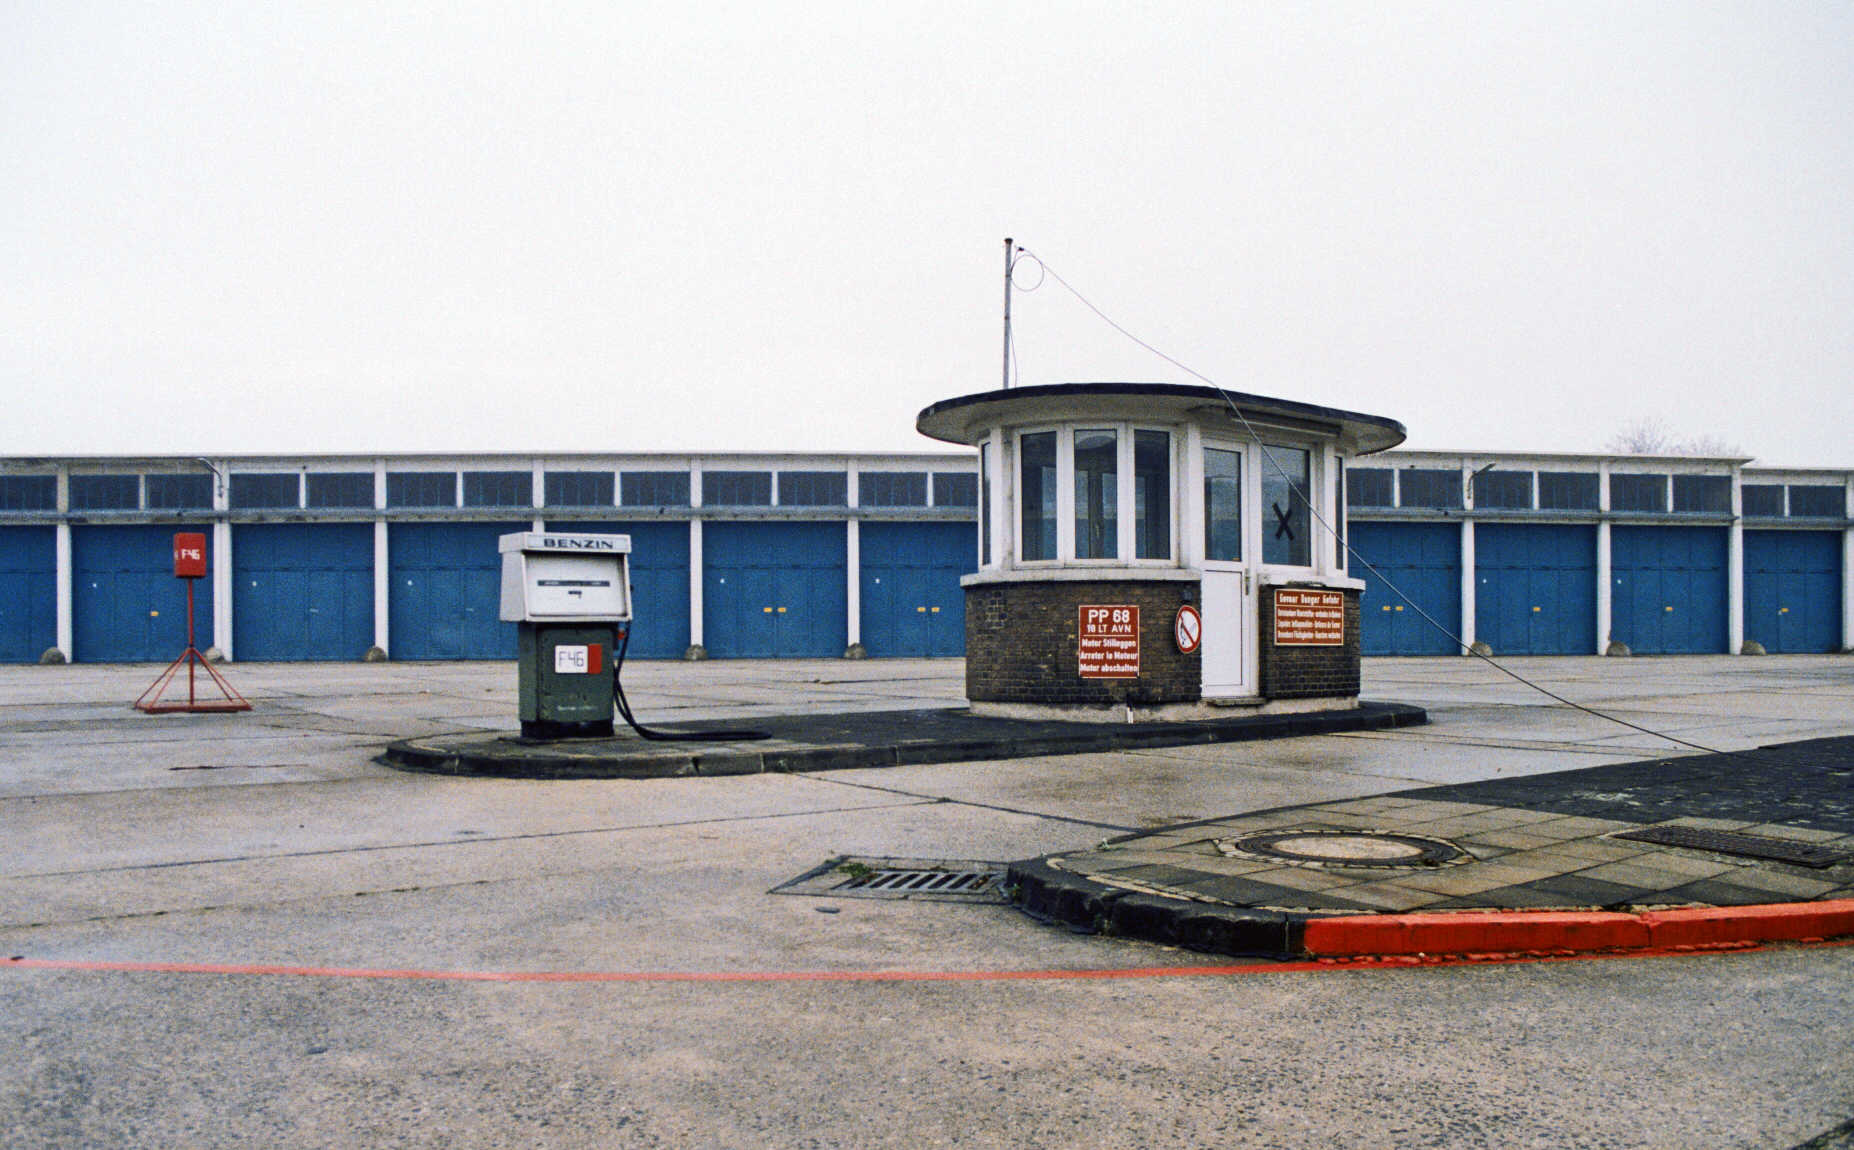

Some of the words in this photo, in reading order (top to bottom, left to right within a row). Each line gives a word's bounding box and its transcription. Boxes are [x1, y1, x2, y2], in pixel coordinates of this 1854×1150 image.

[543, 538, 614, 550] BENZIN
[1300, 593, 1320, 606] Danger
[1322, 594, 1340, 605] Gefahr
[1088, 609, 1109, 623] PP
[1112, 609, 1130, 623] 68
[1087, 624, 1096, 633] 18
[1098, 624, 1107, 633] LT
[1111, 624, 1131, 633] AVN
[1081, 638, 1102, 647] Motor
[1102, 638, 1137, 649] Stilleggen
[558, 650, 585, 667] F46
[1106, 650, 1113, 660] le
[1114, 650, 1138, 660] Moteur
[1080, 662, 1100, 672] Motor
[1101, 662, 1138, 672] abschalten
